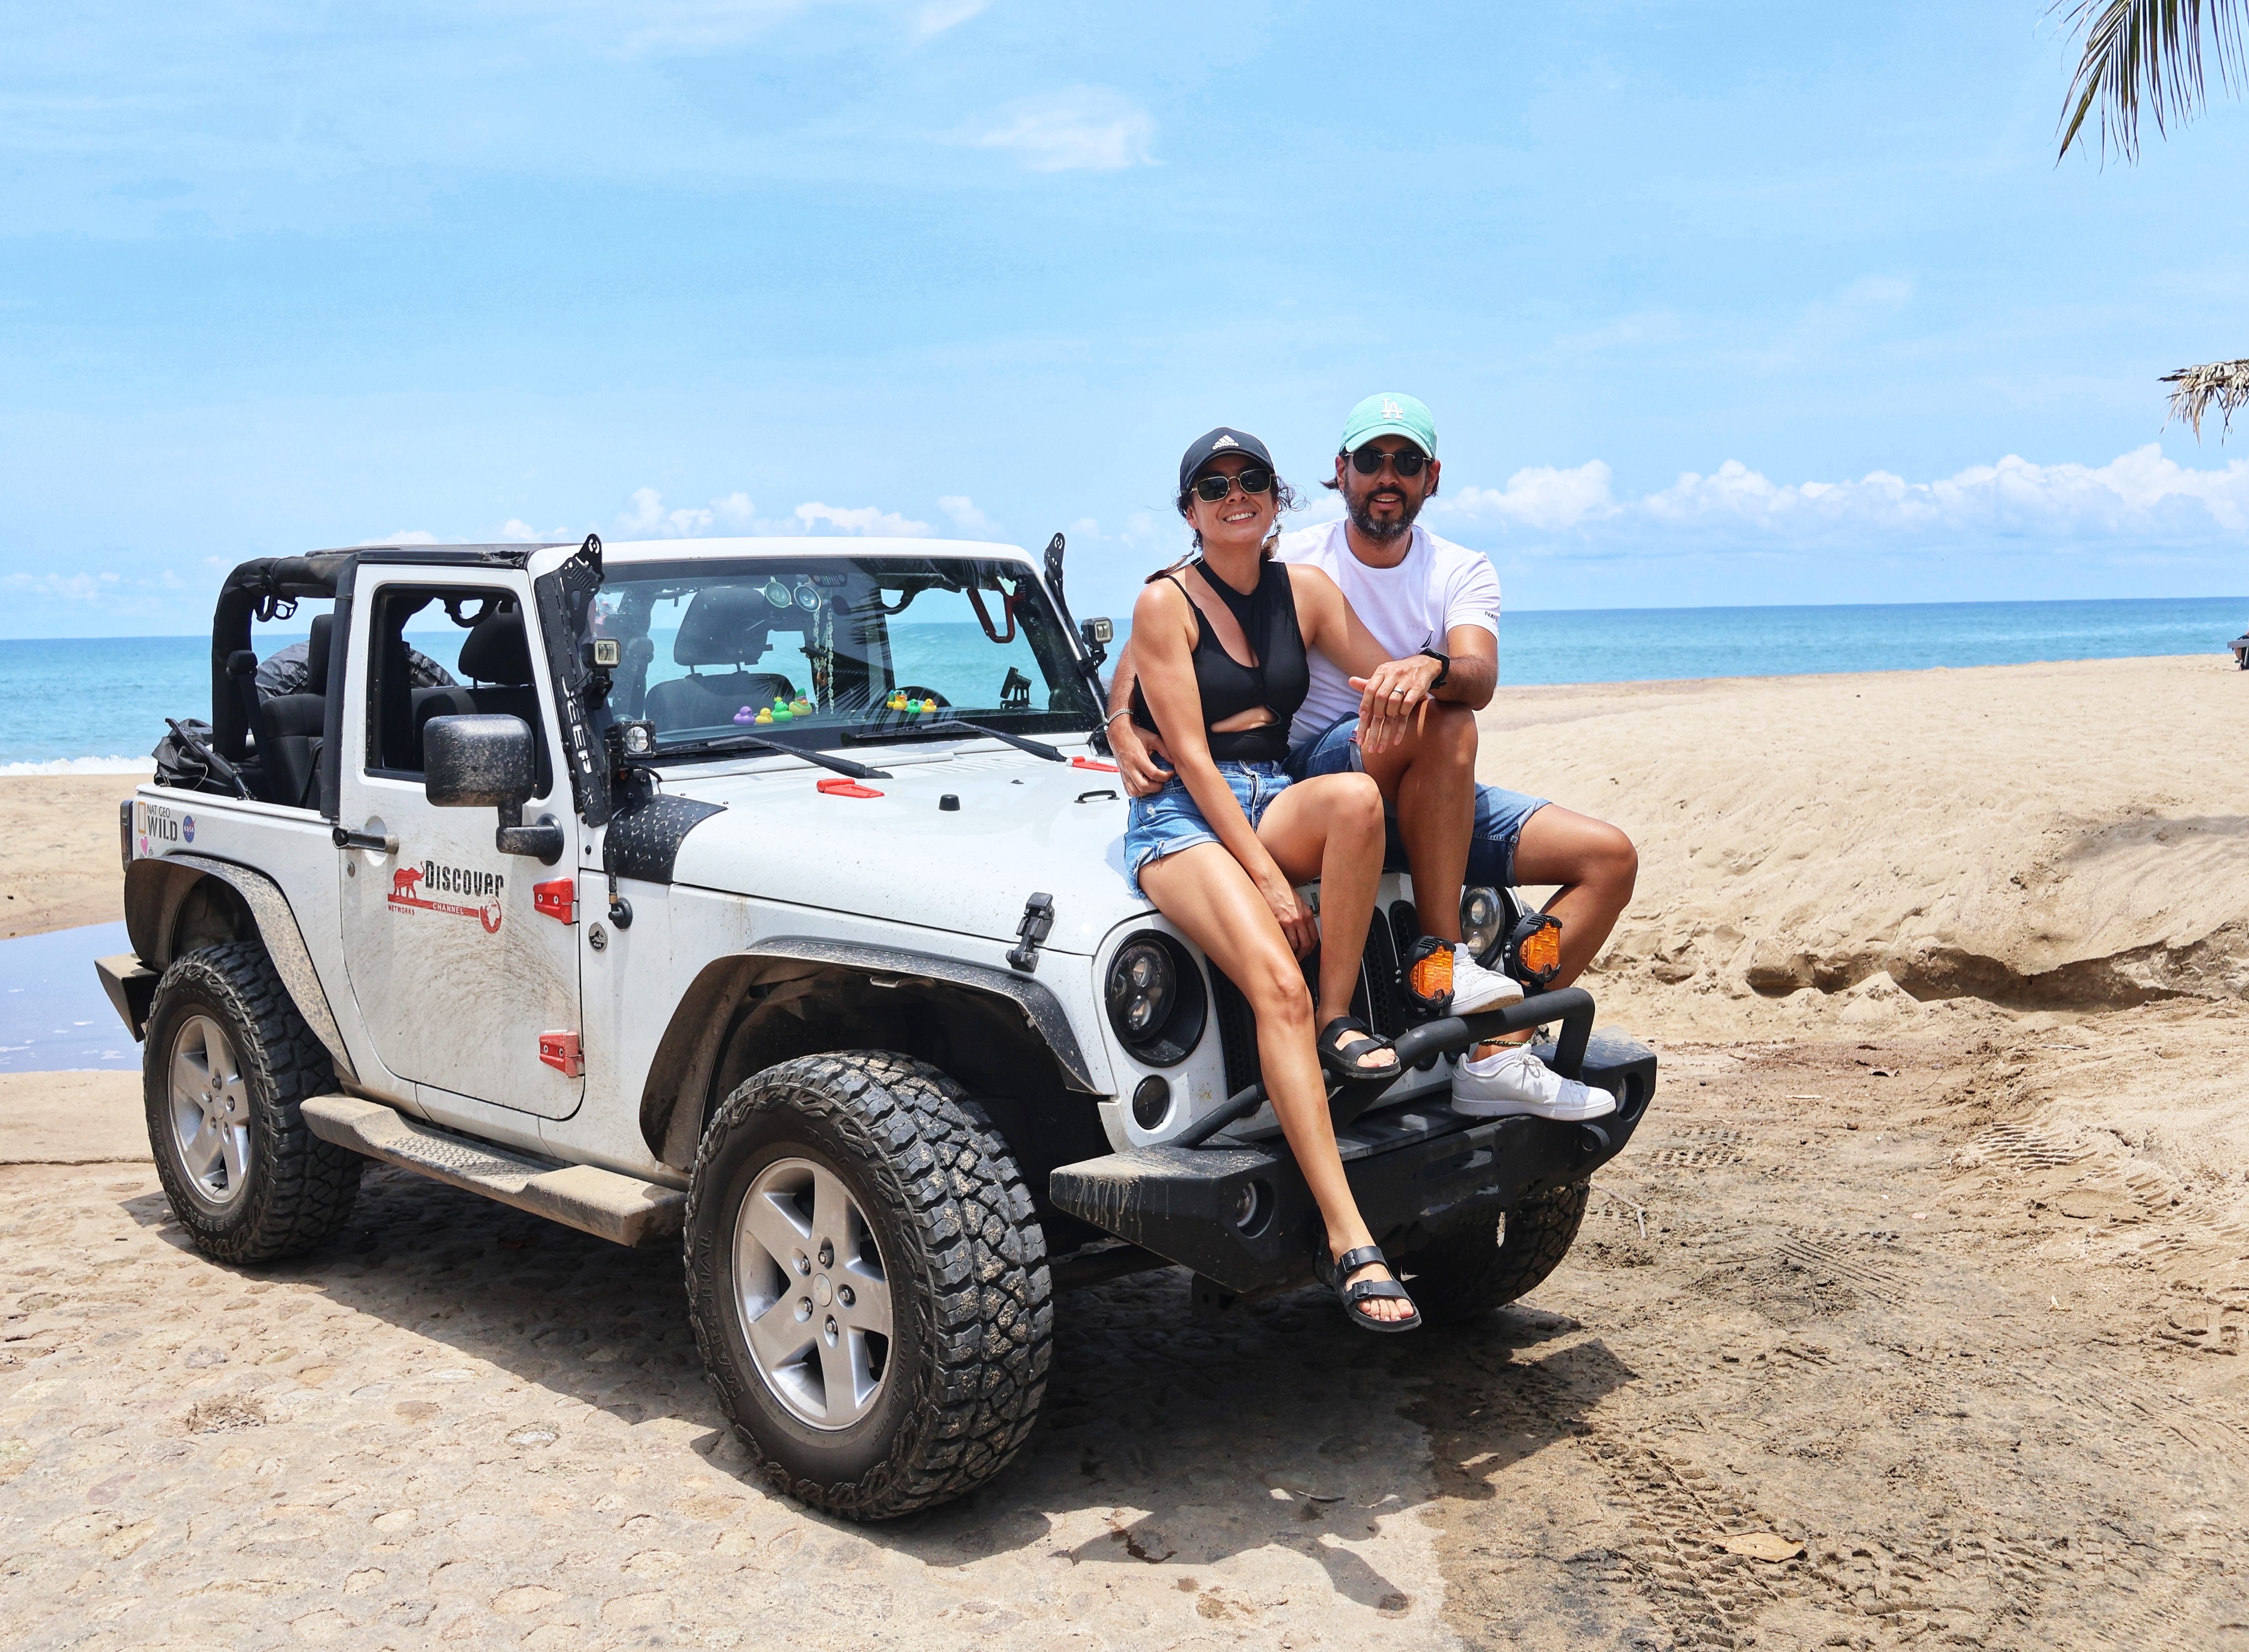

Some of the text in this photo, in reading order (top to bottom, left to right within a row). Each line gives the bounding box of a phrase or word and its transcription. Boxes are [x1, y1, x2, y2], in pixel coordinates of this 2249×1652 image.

[1381, 398, 1403, 420] LA
[1212, 441, 1239, 450] adidas
[562, 675, 593, 774] JEEP
[147, 803, 171, 818] NAT GEO
[147, 815, 178, 842] WILD
[388, 904, 415, 916] NETWORKS
[433, 902, 464, 915] CHANNEL
[700, 1230, 743, 1399] MARSHAL
